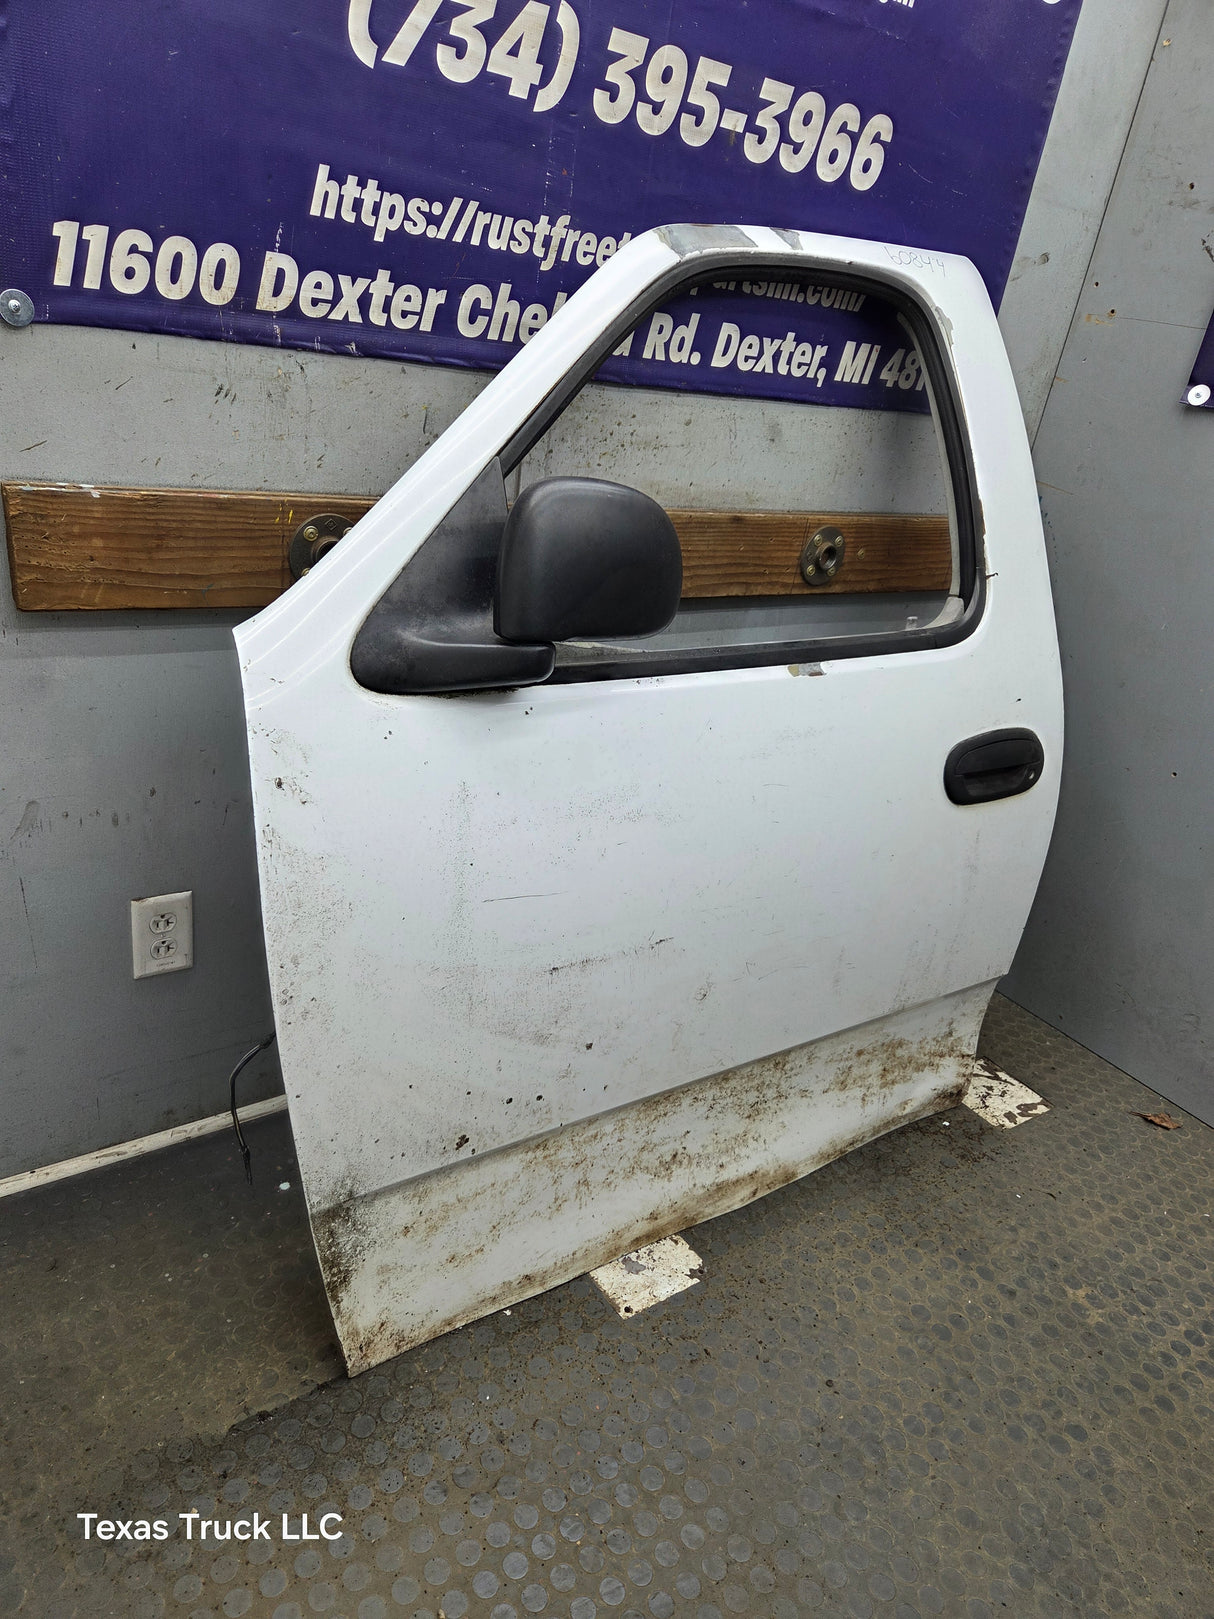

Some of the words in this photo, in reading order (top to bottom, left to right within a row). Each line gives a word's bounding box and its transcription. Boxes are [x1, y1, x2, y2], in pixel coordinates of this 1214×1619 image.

[348, 0, 580, 112] (734)
[593, 27, 893, 191] 395-3966
[53, 220, 240, 305] 11600
[256, 251, 446, 331] Dexter
[642, 312, 701, 365] Rd.
[711, 322, 828, 387] Dexter,
[834, 341, 881, 384] MI
